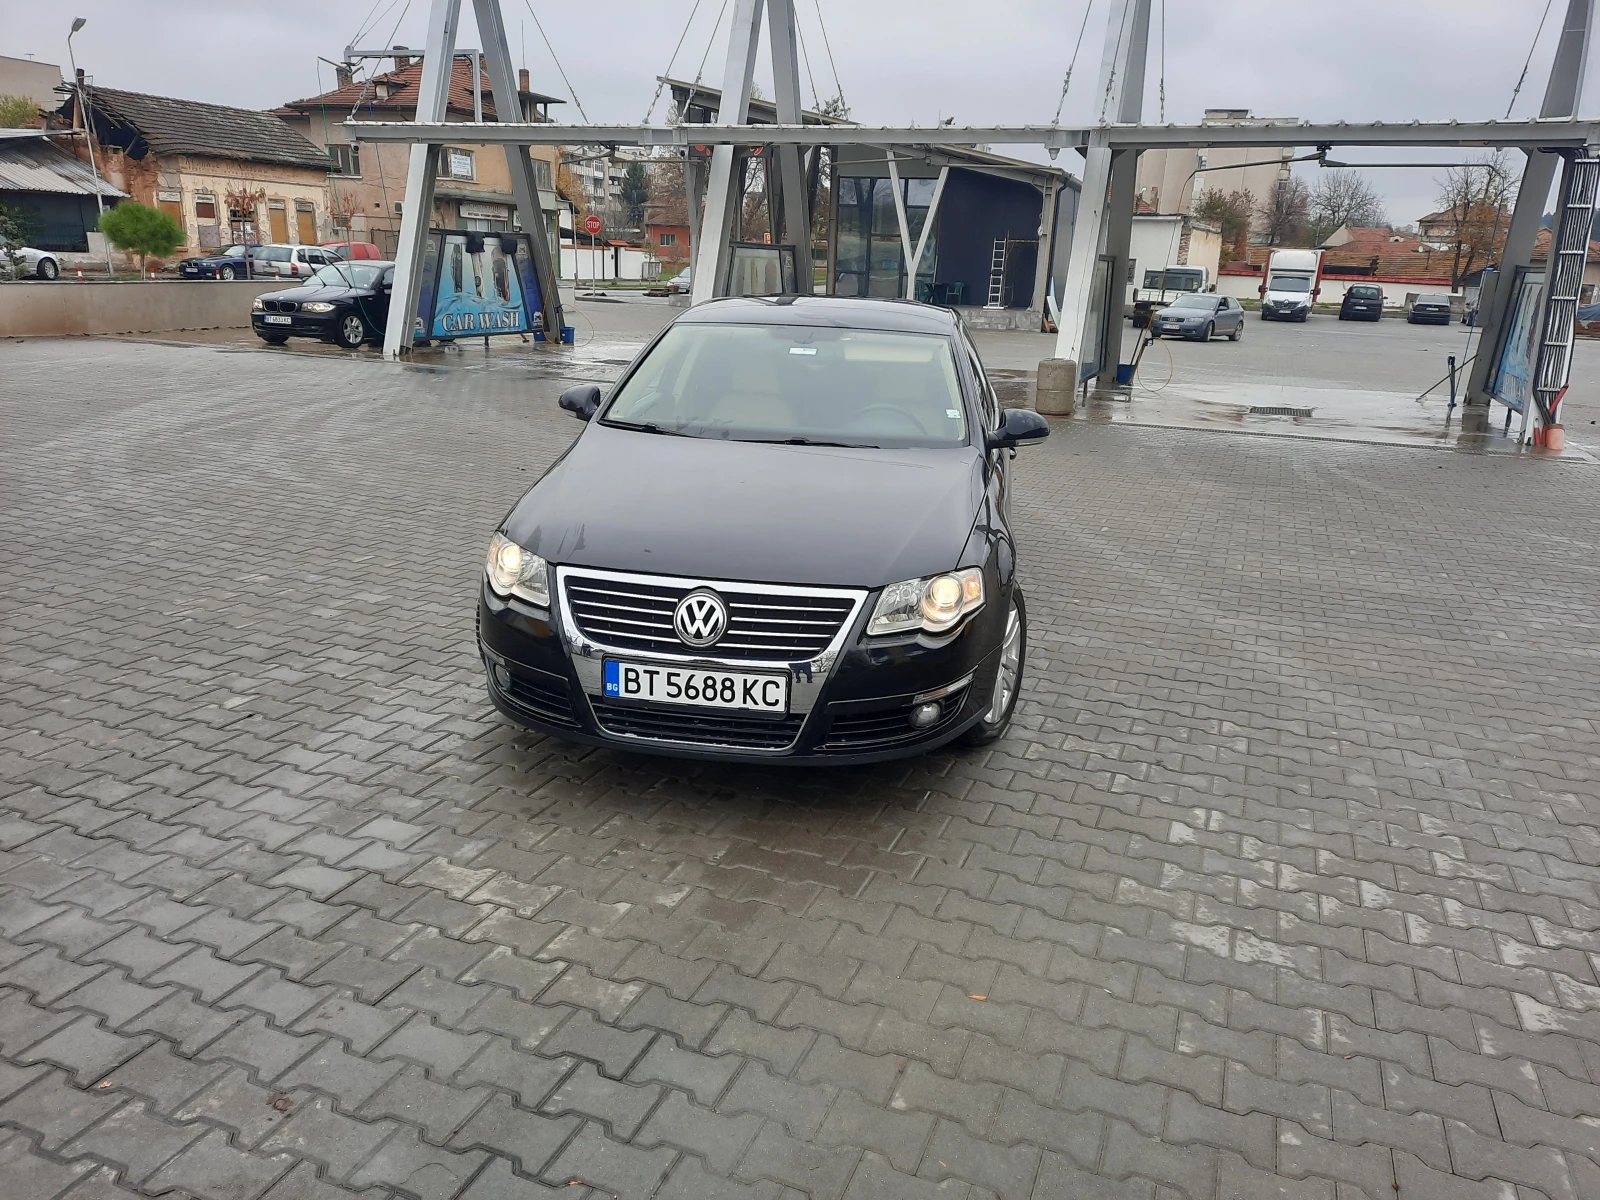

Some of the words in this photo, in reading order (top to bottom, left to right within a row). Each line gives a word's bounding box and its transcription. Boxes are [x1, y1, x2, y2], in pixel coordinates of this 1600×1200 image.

[586, 220, 600, 229] STOP
[442, 313, 475, 331] CAR
[479, 311, 520, 329] WASH
[606, 682, 619, 692] BG
[624, 667, 660, 696] BT
[666, 672, 736, 703] 5688
[742, 678, 780, 707] KC
